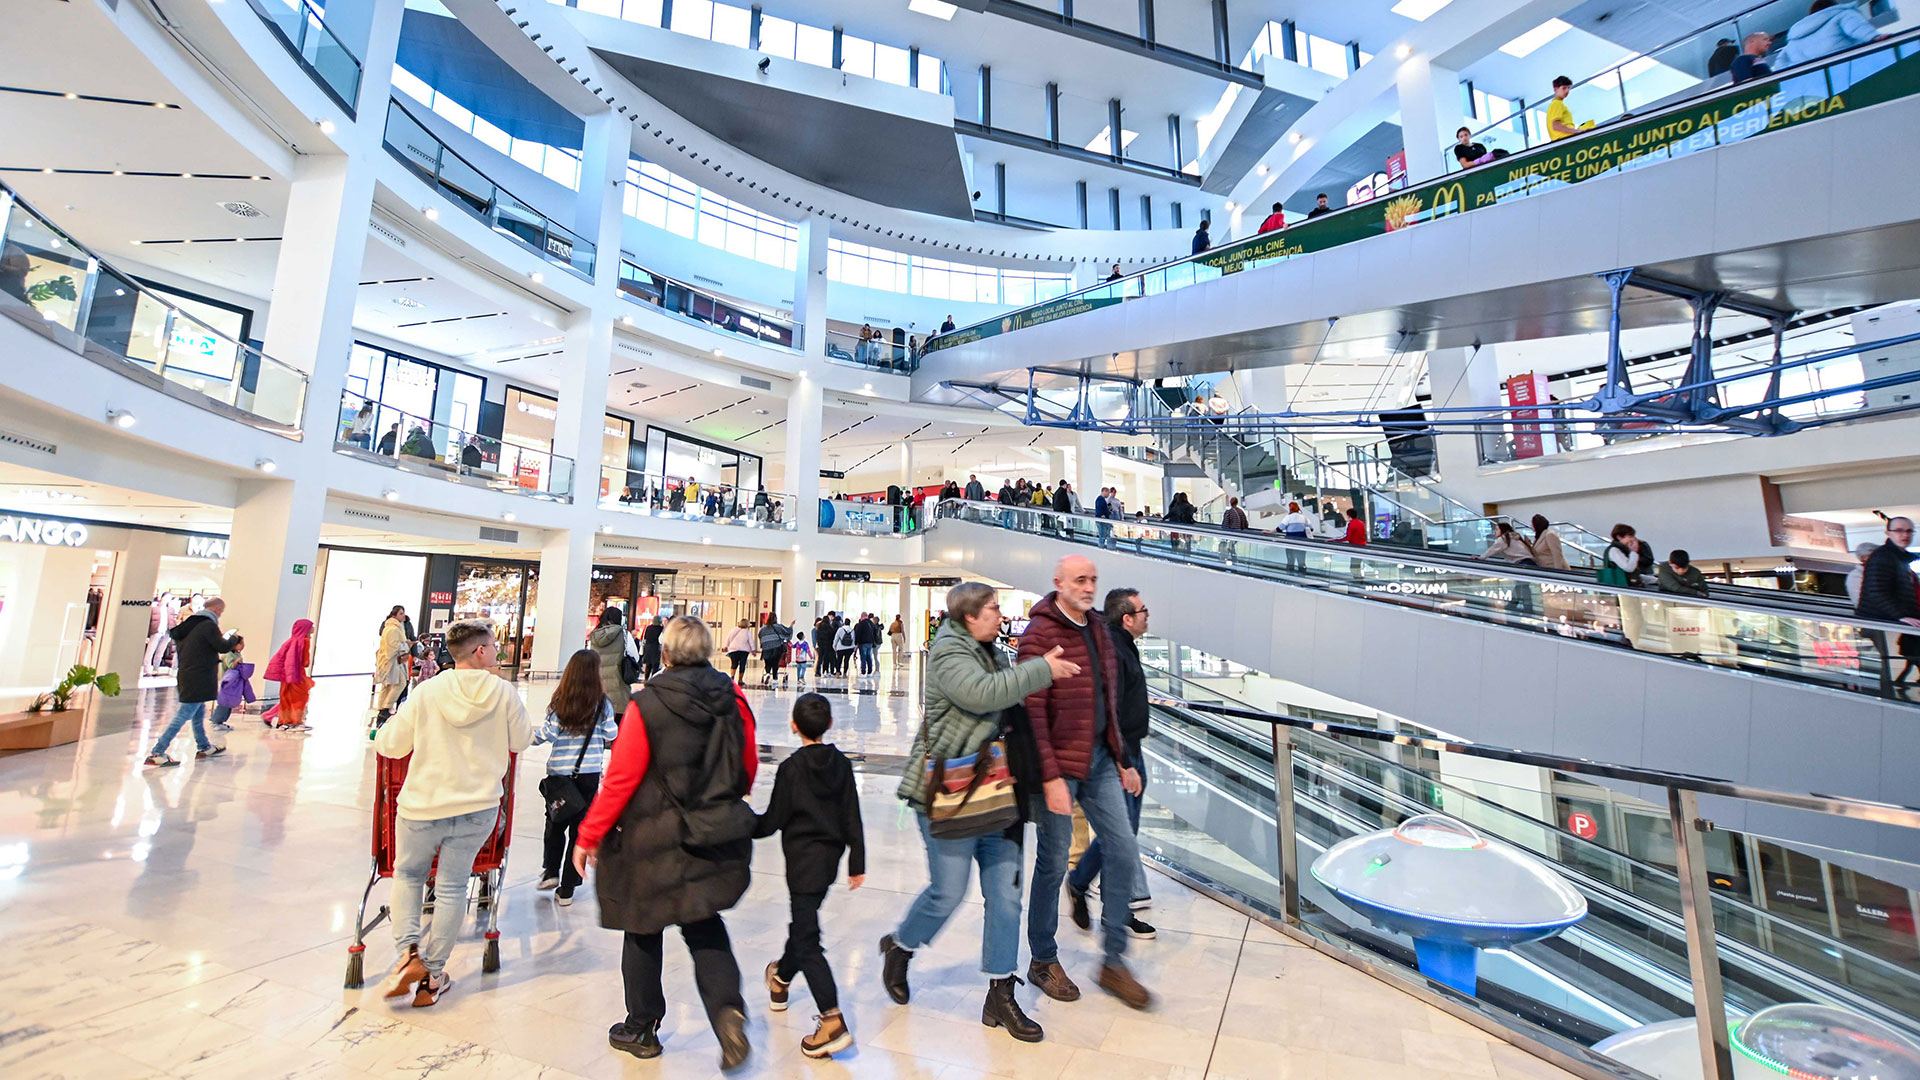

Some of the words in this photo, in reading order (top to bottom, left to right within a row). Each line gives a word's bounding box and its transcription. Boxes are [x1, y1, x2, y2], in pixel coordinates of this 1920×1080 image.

[1508, 156, 1562, 182] NUEVO
[1565, 139, 1624, 167] LOCAL
[1628, 118, 1693, 149] JUNTO
[1698, 110, 1721, 130] AL
[1732, 90, 1786, 118] CINE
[1476, 184, 1516, 206] PARA
[1576, 160, 1612, 179] UNA
[1617, 139, 1682, 168] MEJOR
[1688, 95, 1846, 149] EXPERIENCIA
[1229, 248, 1253, 263] JUNTO
[1253, 245, 1264, 256] AL
[1265, 238, 1285, 251] CINE
[1223, 259, 1249, 274] MEJO
[0, 516, 89, 547] ANGO
[121, 599, 152, 607] MANGO
[1575, 816, 1590, 834] P
[1856, 903, 1890, 918] SALERA
